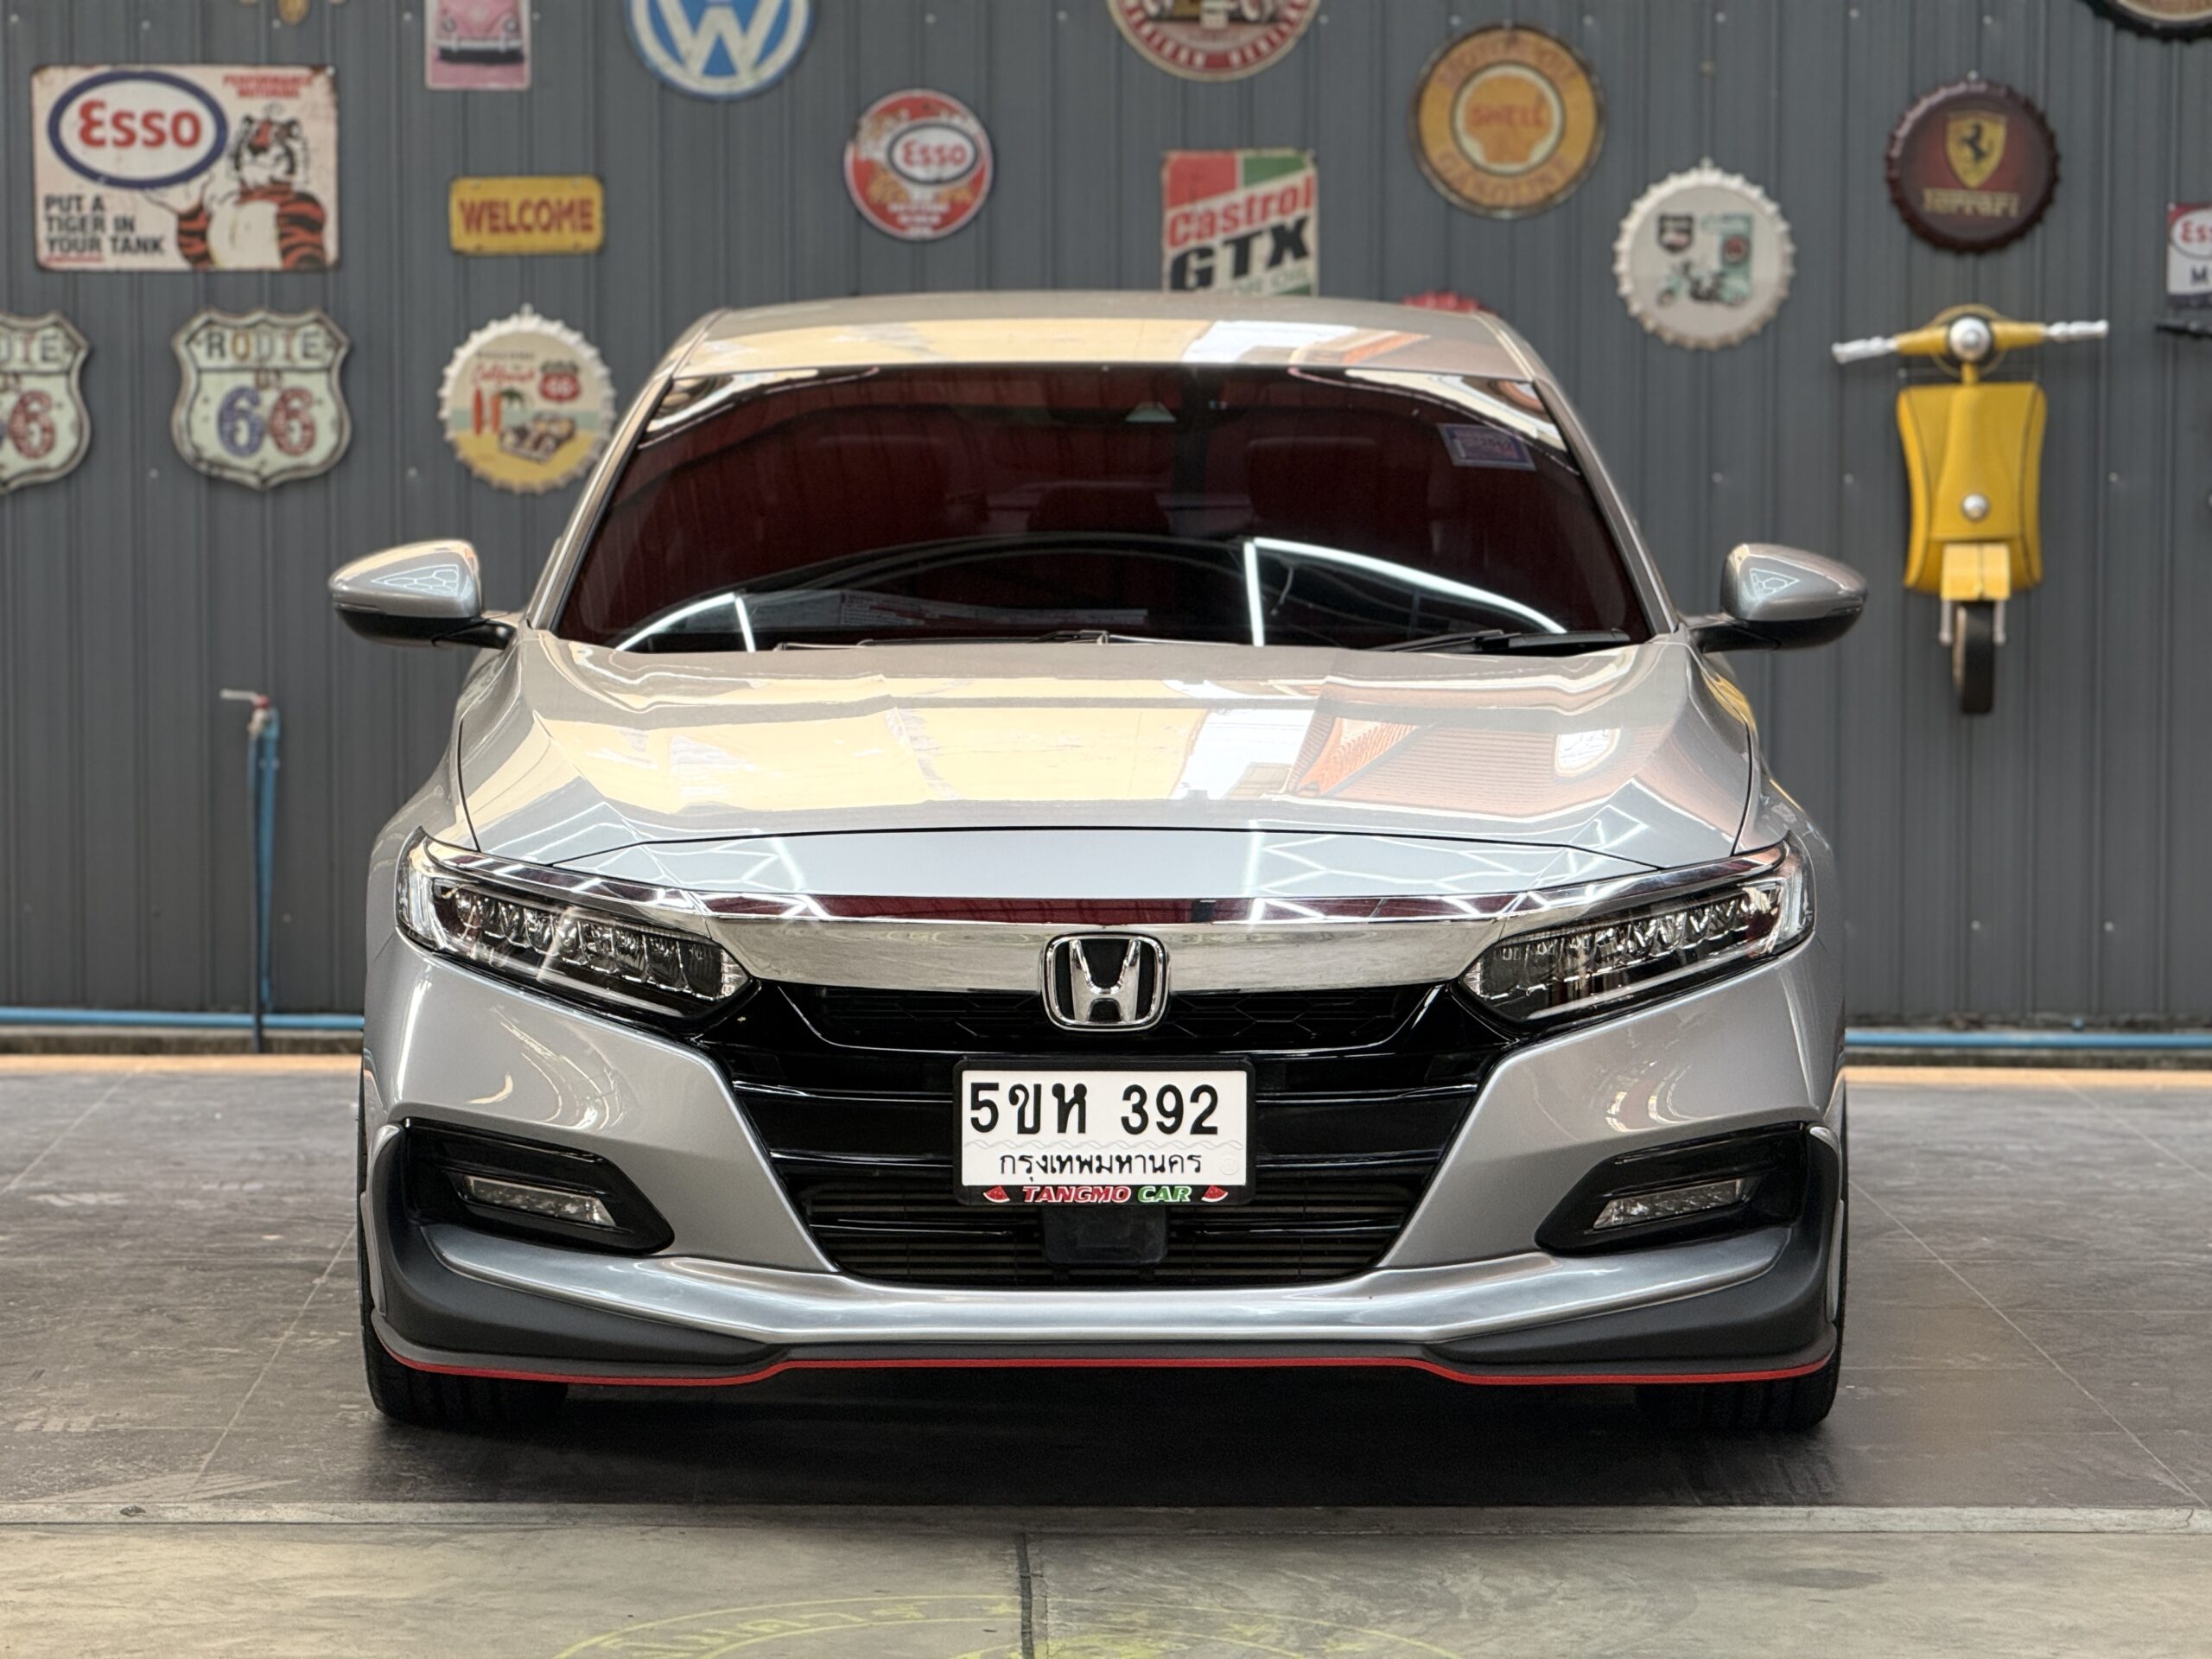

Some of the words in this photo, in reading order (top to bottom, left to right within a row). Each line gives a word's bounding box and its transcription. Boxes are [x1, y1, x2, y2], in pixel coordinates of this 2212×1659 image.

[903, 141, 967, 167] Esso
[45, 195, 83, 212] PUT
[92, 195, 105, 212] A
[459, 198, 594, 234] WELCOME
[1168, 176, 1313, 249] Castrol
[1923, 188, 2018, 218] Ferrari
[46, 216, 105, 233] TIGER
[114, 216, 135, 233] IN
[47, 236, 102, 253] YOUR
[111, 235, 164, 253] TANK
[1170, 216, 1311, 292] GTX
[206, 329, 324, 362] ROUTE
[218, 387, 317, 458] 66
[970, 1082, 1088, 1135] 5ขห
[1121, 1084, 1219, 1135] 392
[1000, 1154, 1203, 1182] กรุงเทพมหานคร
[1022, 1185, 1132, 1205] TANGMO
[1137, 1185, 1192, 1204] CAR
